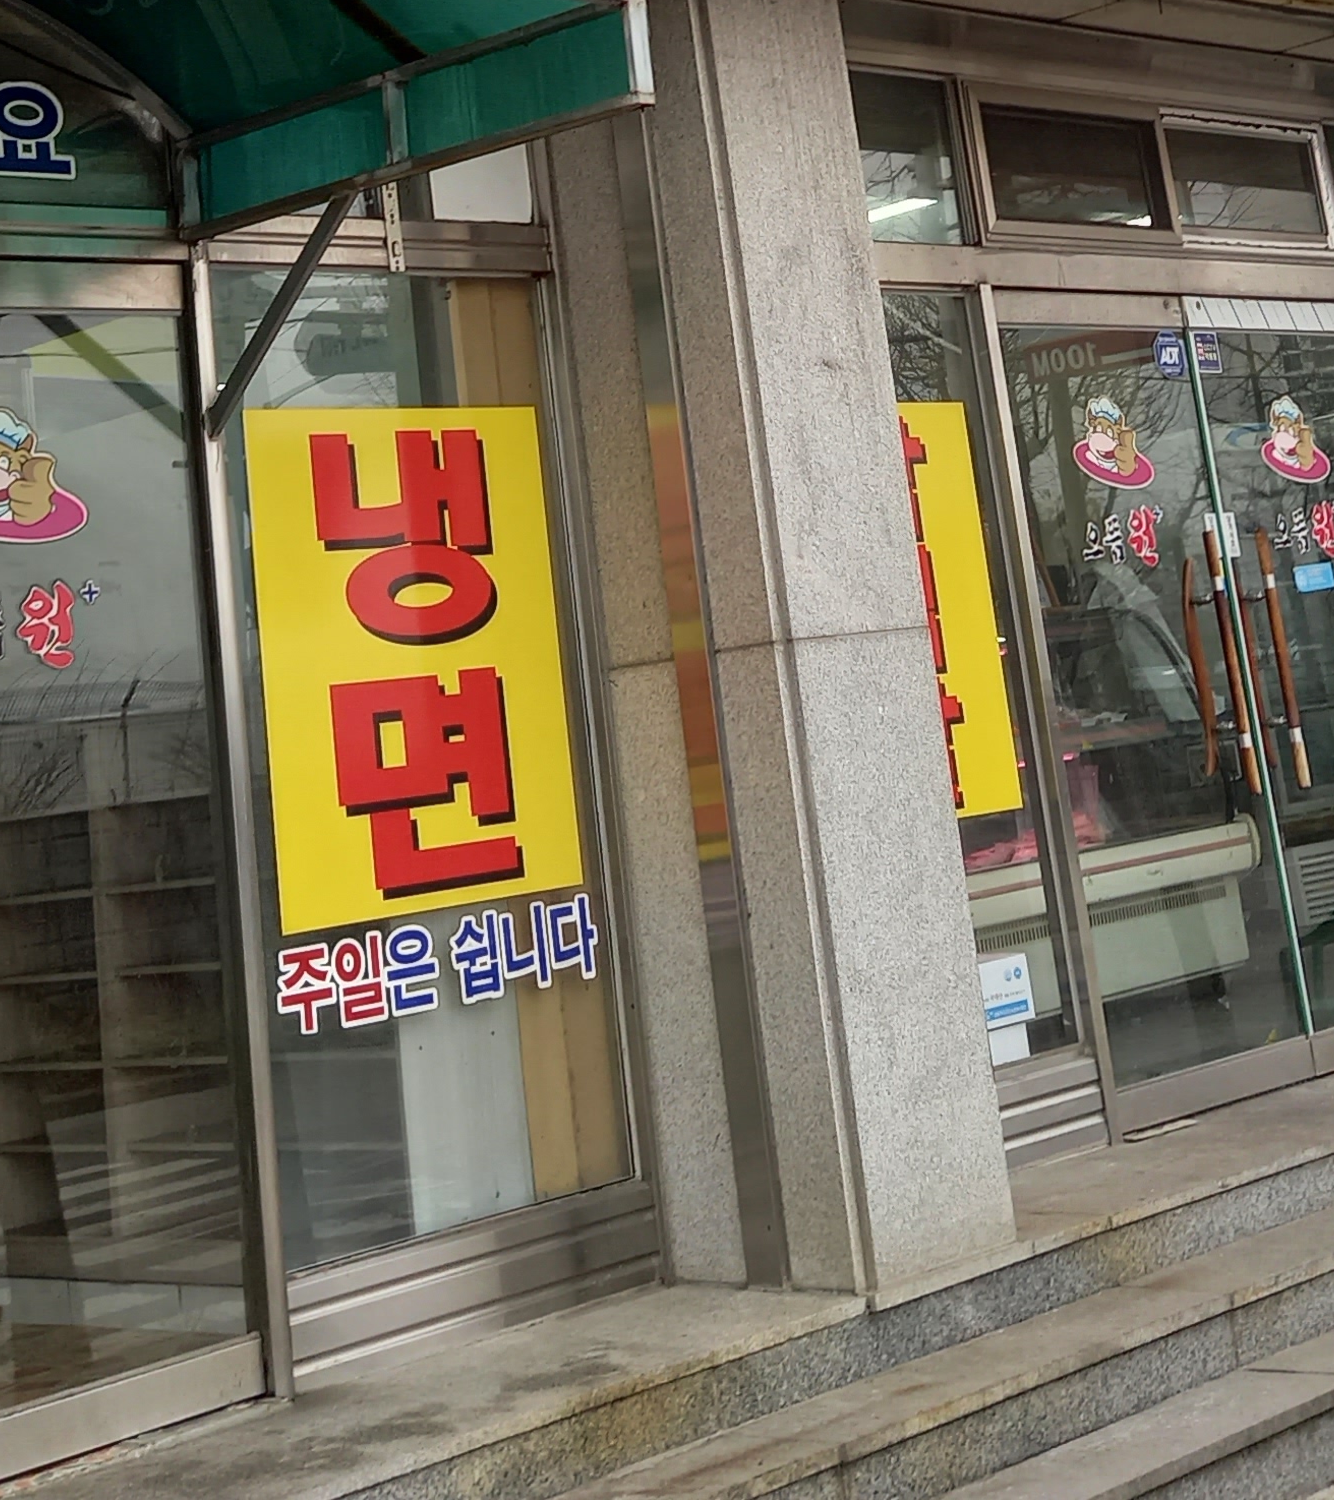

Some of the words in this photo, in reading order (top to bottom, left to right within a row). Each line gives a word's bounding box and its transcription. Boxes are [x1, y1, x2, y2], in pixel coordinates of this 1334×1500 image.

[1160, 346, 1180, 366] ADT
[308, 428, 526, 900] 냉면
[277, 922, 440, 1035] 주일은
[450, 893, 600, 1006] 쉽니다
